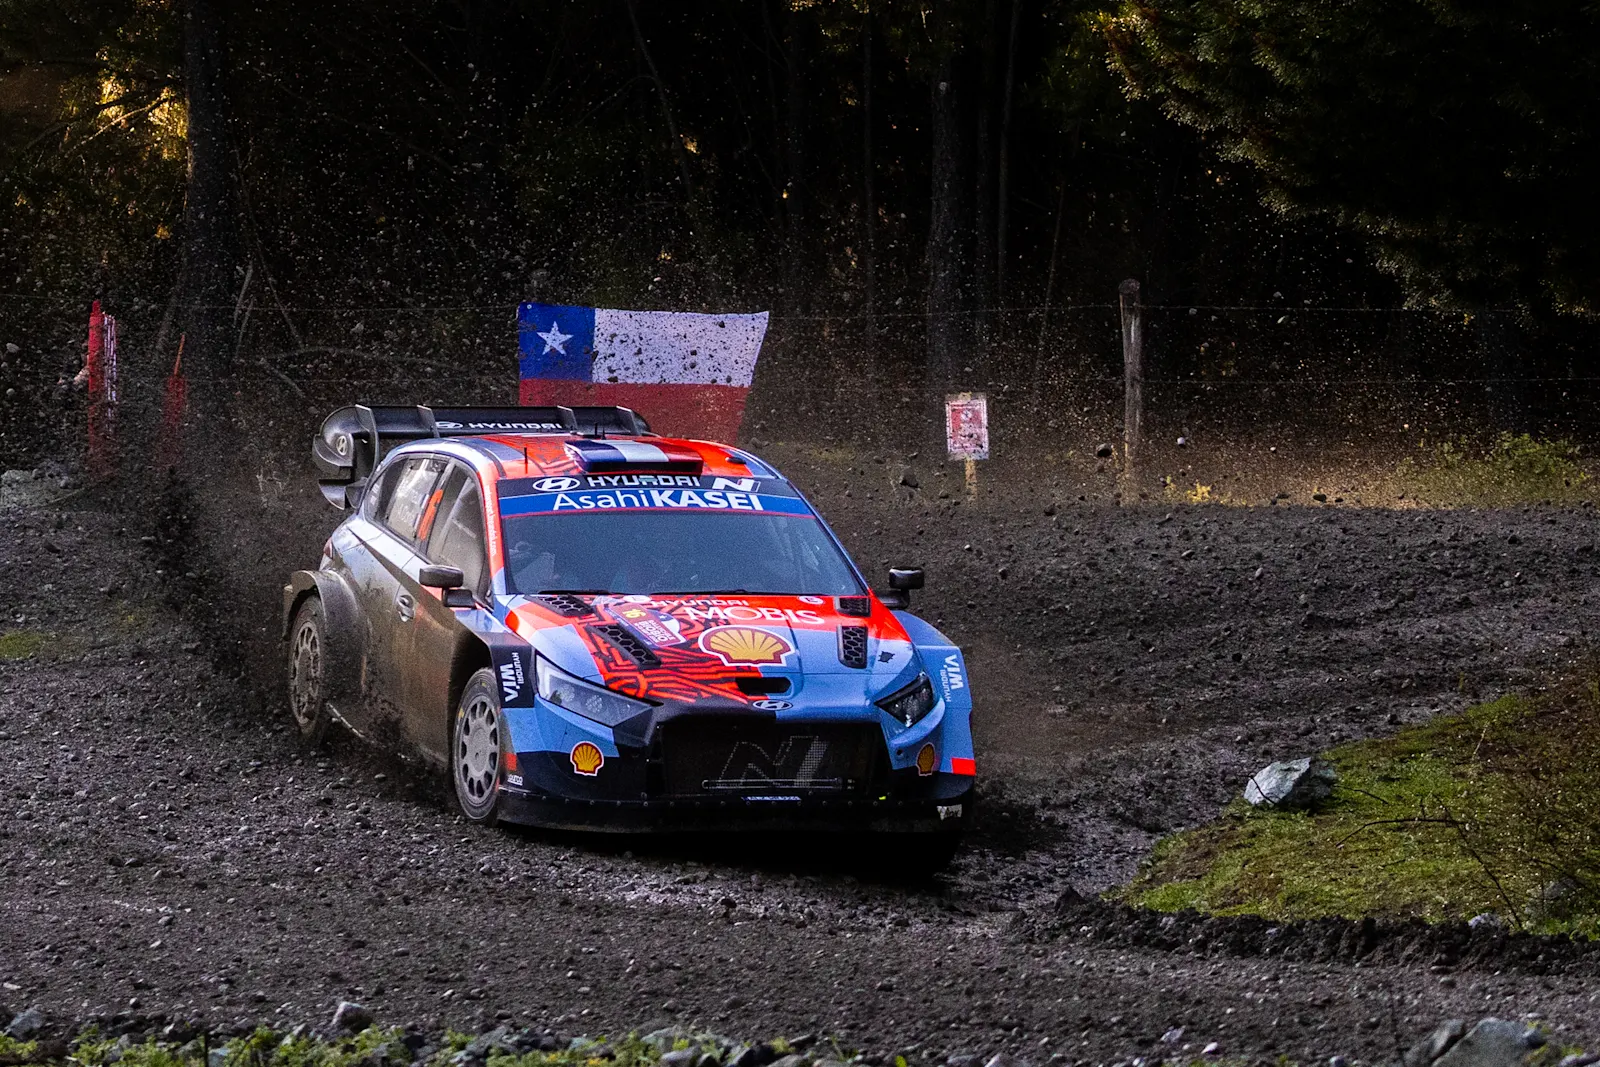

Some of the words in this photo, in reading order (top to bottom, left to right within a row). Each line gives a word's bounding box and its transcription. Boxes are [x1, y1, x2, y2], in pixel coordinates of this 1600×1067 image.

[468, 421, 562, 430] HYUNDAI
[587, 475, 700, 487] HYUNDAI
[711, 477, 761, 492] N
[649, 599, 749, 607] HYUNDAI
[683, 605, 825, 624] MOBIS
[511, 652, 524, 684] HYUNDAI
[944, 655, 963, 689] WIA
[500, 663, 519, 702] WIA
[940, 669, 951, 702] HYUNDAI
